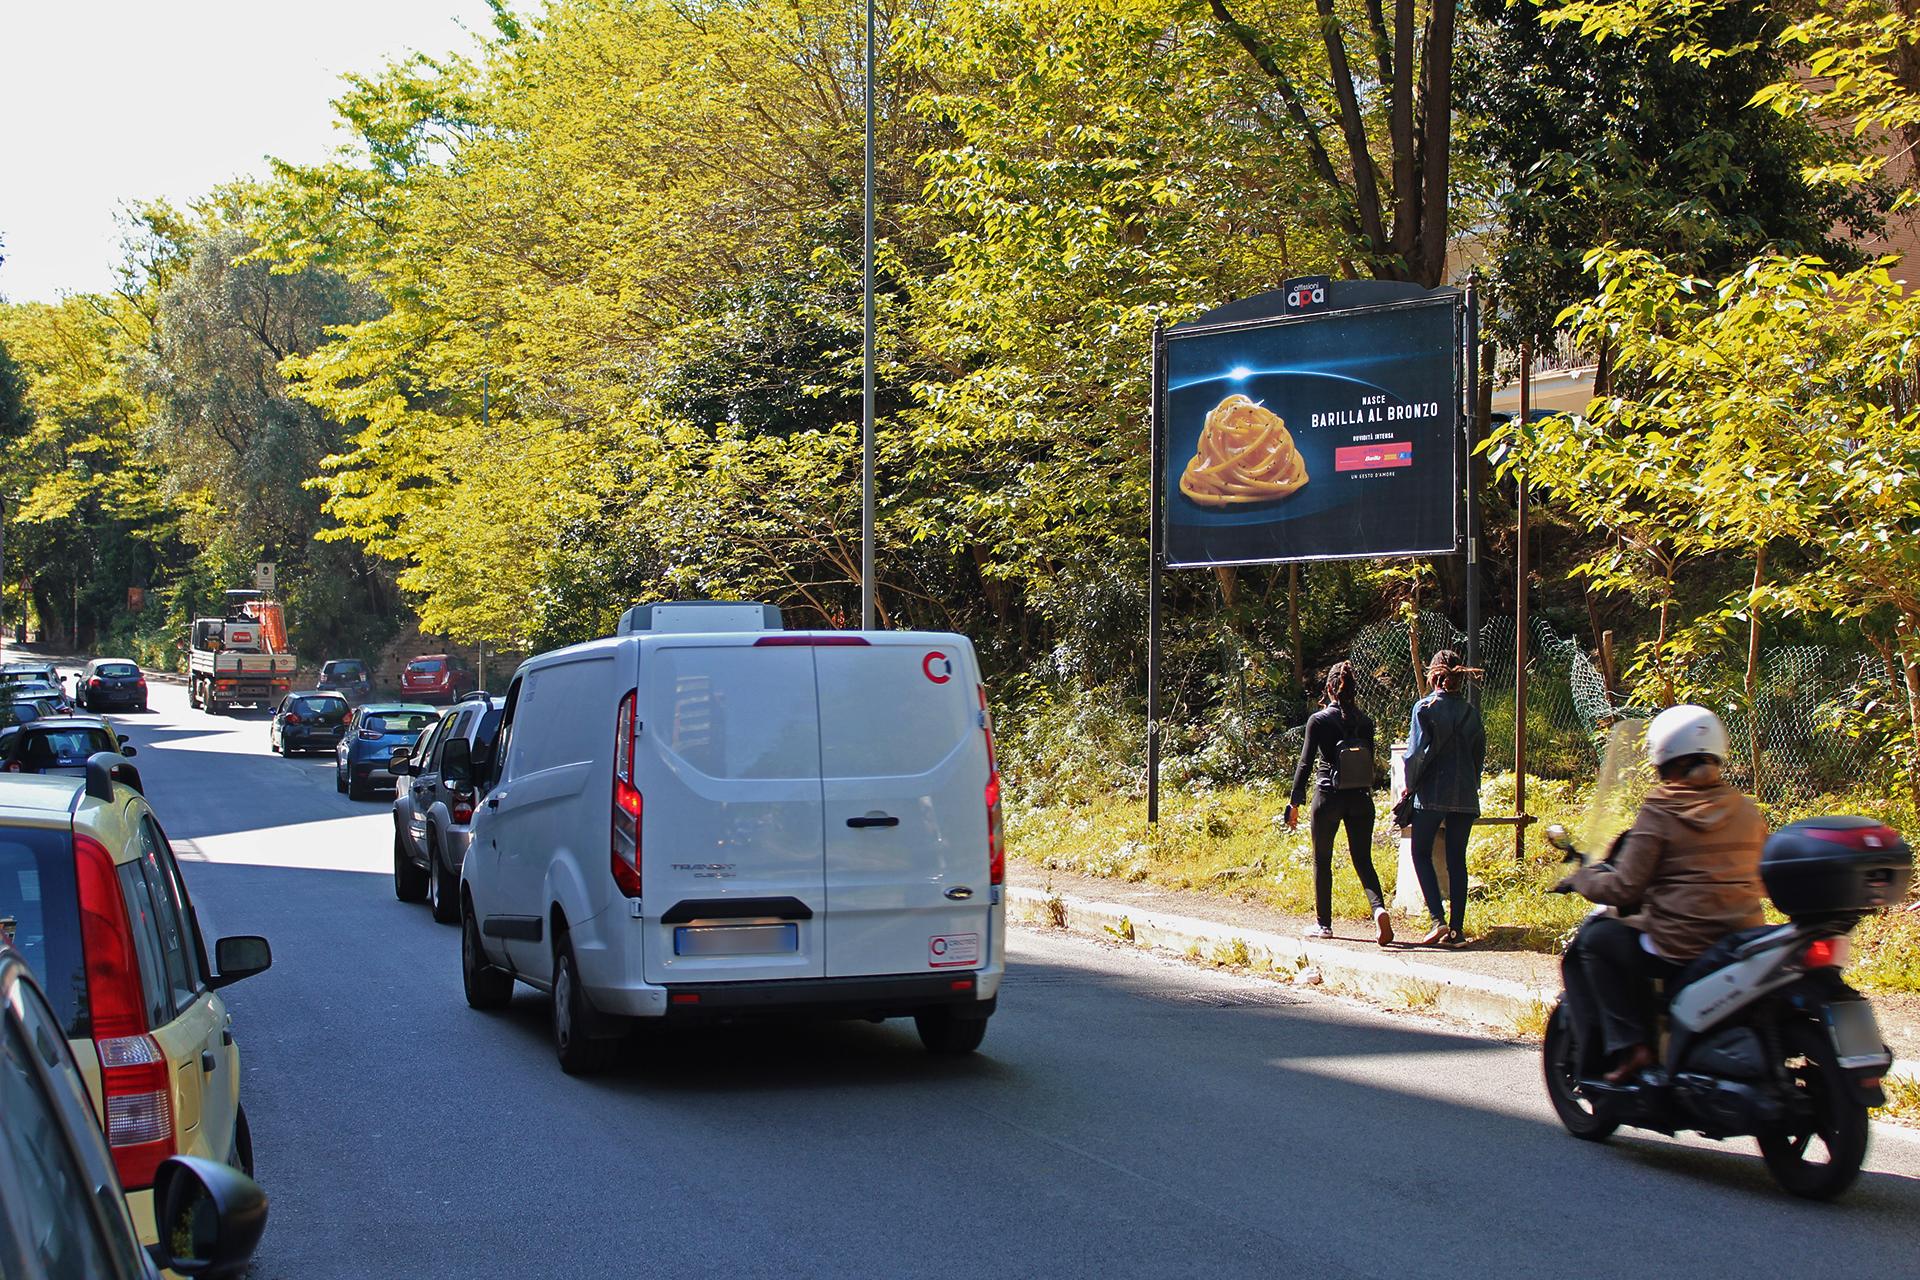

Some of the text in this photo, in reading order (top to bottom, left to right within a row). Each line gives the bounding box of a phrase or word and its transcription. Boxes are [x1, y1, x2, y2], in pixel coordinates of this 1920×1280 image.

[1287, 288, 1324, 308] apa
[1362, 395, 1386, 406] NASCE
[1311, 402, 1438, 428] BARILLA AL BRONZO
